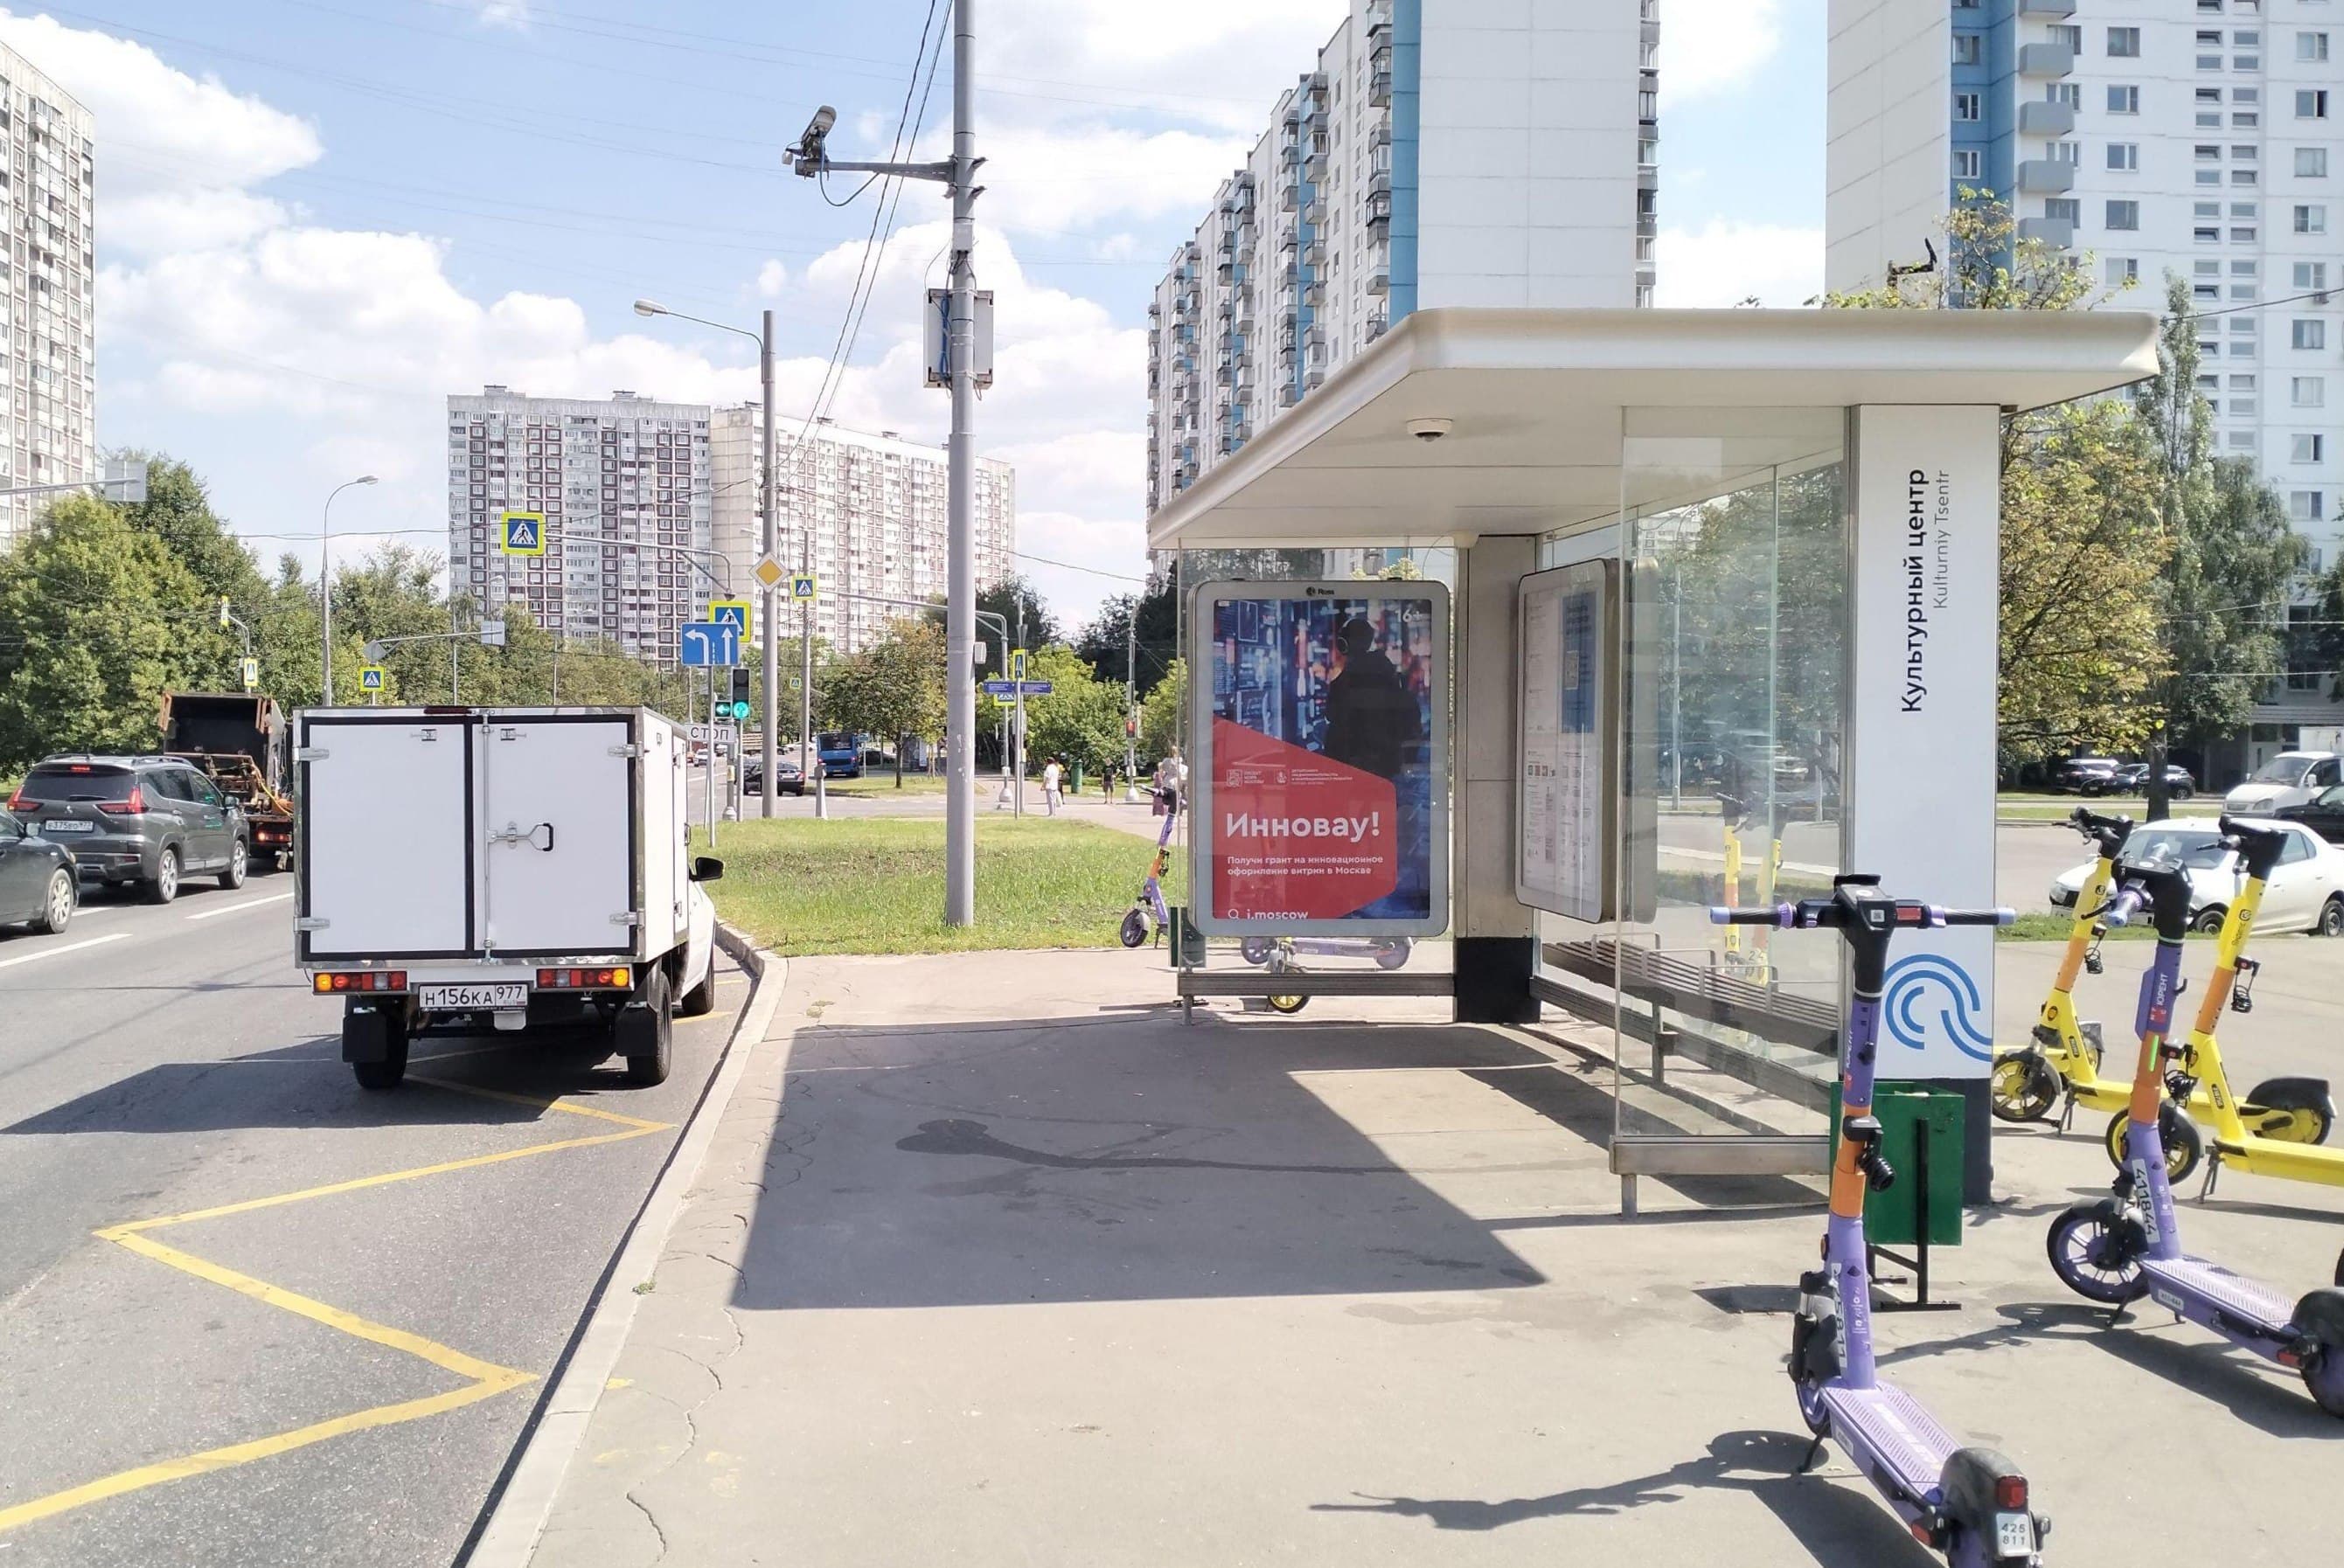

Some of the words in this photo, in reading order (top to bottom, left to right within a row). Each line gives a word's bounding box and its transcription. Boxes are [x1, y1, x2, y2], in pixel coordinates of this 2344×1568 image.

[1908, 468, 1930, 547] центр
[1934, 469, 1950, 525] Tsentr
[1932, 529, 1951, 608] Kulturniy
[1901, 556, 1928, 712] Культурный
[691, 726, 729, 740] СТОП
[1226, 811, 1381, 843] Инновау!
[1227, 856, 1263, 866] Получи
[1265, 857, 1292, 865] грант
[1308, 856, 1384, 865] инновационное
[1227, 866, 1289, 878] оформление
[1290, 868, 1325, 877] витрин
[1335, 866, 1372, 875] Москве
[1246, 908, 1309, 919] i.moscow
[425, 988, 493, 1005] Н156КА
[496, 986, 523, 1000] 977
[2156, 973, 2169, 1006] ЮРЕНТ
[2135, 1168, 2157, 1235] 411844
[2001, 1523, 2027, 1533] 425
[2002, 1535, 2026, 1545] 811
